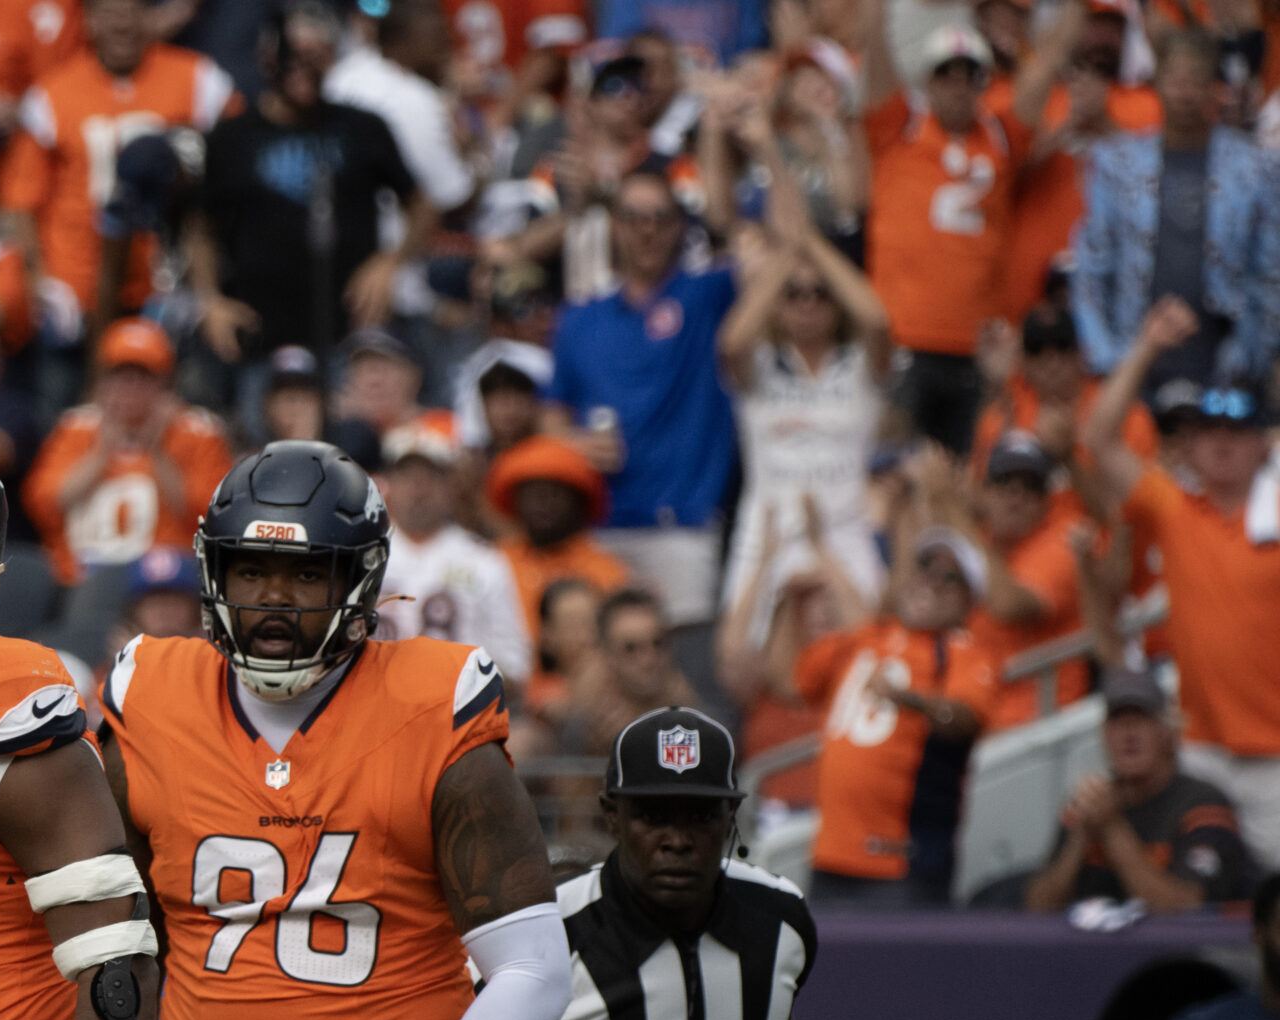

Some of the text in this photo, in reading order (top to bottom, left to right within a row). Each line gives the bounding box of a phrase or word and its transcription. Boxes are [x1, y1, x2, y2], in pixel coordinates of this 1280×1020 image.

[255, 524, 296, 540] 5280
[663, 745, 695, 766] NFL
[192, 831, 382, 987] 96
